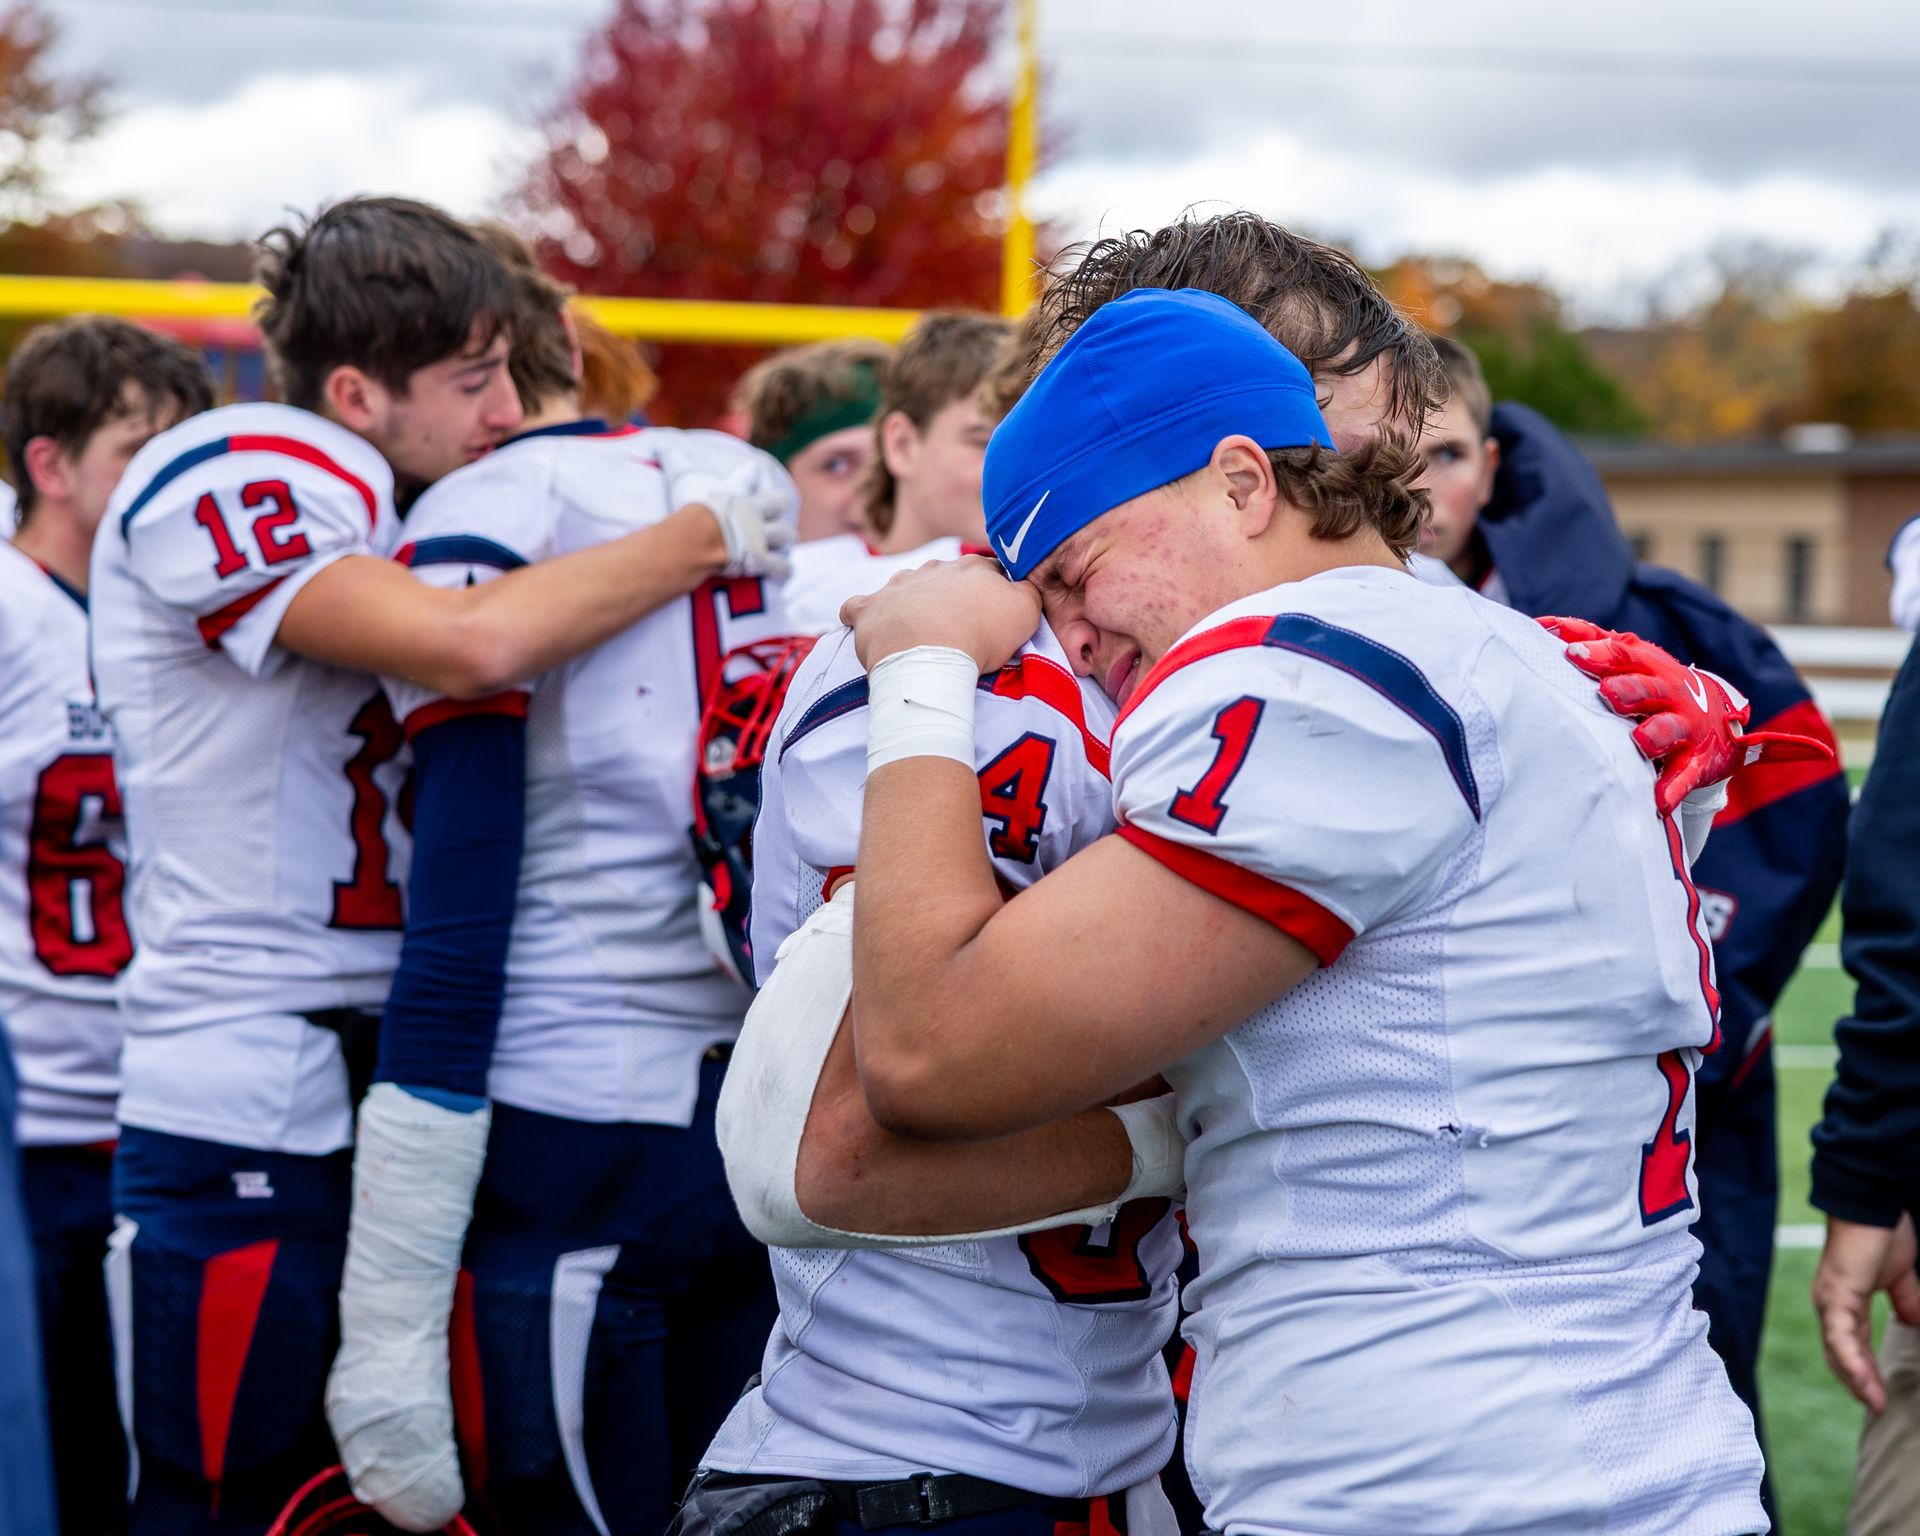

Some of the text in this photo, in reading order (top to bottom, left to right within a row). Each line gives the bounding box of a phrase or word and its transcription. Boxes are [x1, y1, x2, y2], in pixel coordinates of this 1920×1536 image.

[194, 478, 312, 579] 12
[326, 686, 418, 931] 1
[976, 730, 1057, 865] 4
[1167, 693, 1267, 837] 1
[29, 752, 136, 982] 6
